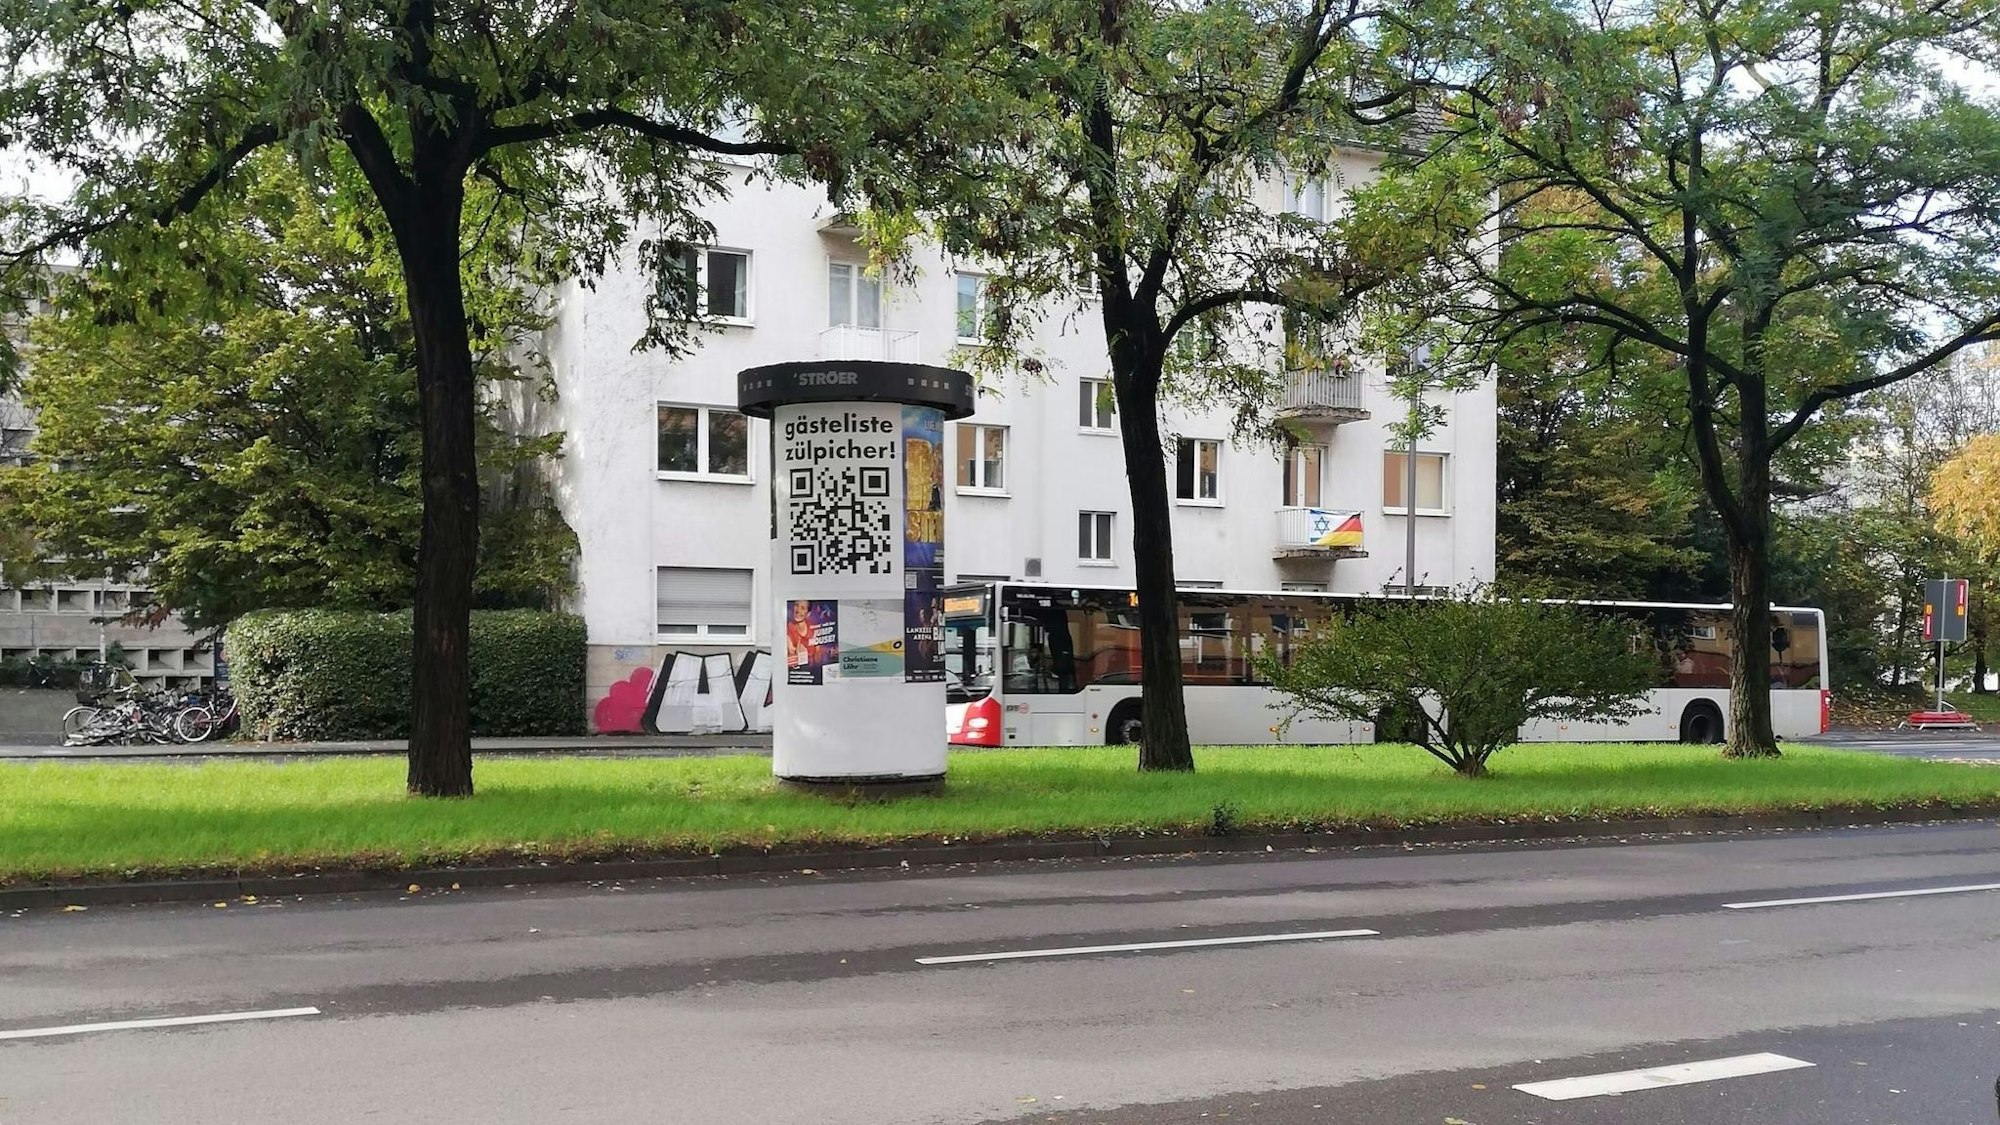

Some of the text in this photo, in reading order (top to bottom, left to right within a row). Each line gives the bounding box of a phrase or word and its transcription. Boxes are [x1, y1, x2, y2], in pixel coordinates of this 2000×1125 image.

[785, 413, 894, 441] gästeliste
[785, 439, 895, 465] zülpicher!
[813, 626, 834, 638] JUMP
[843, 655, 878, 663] Christiane
